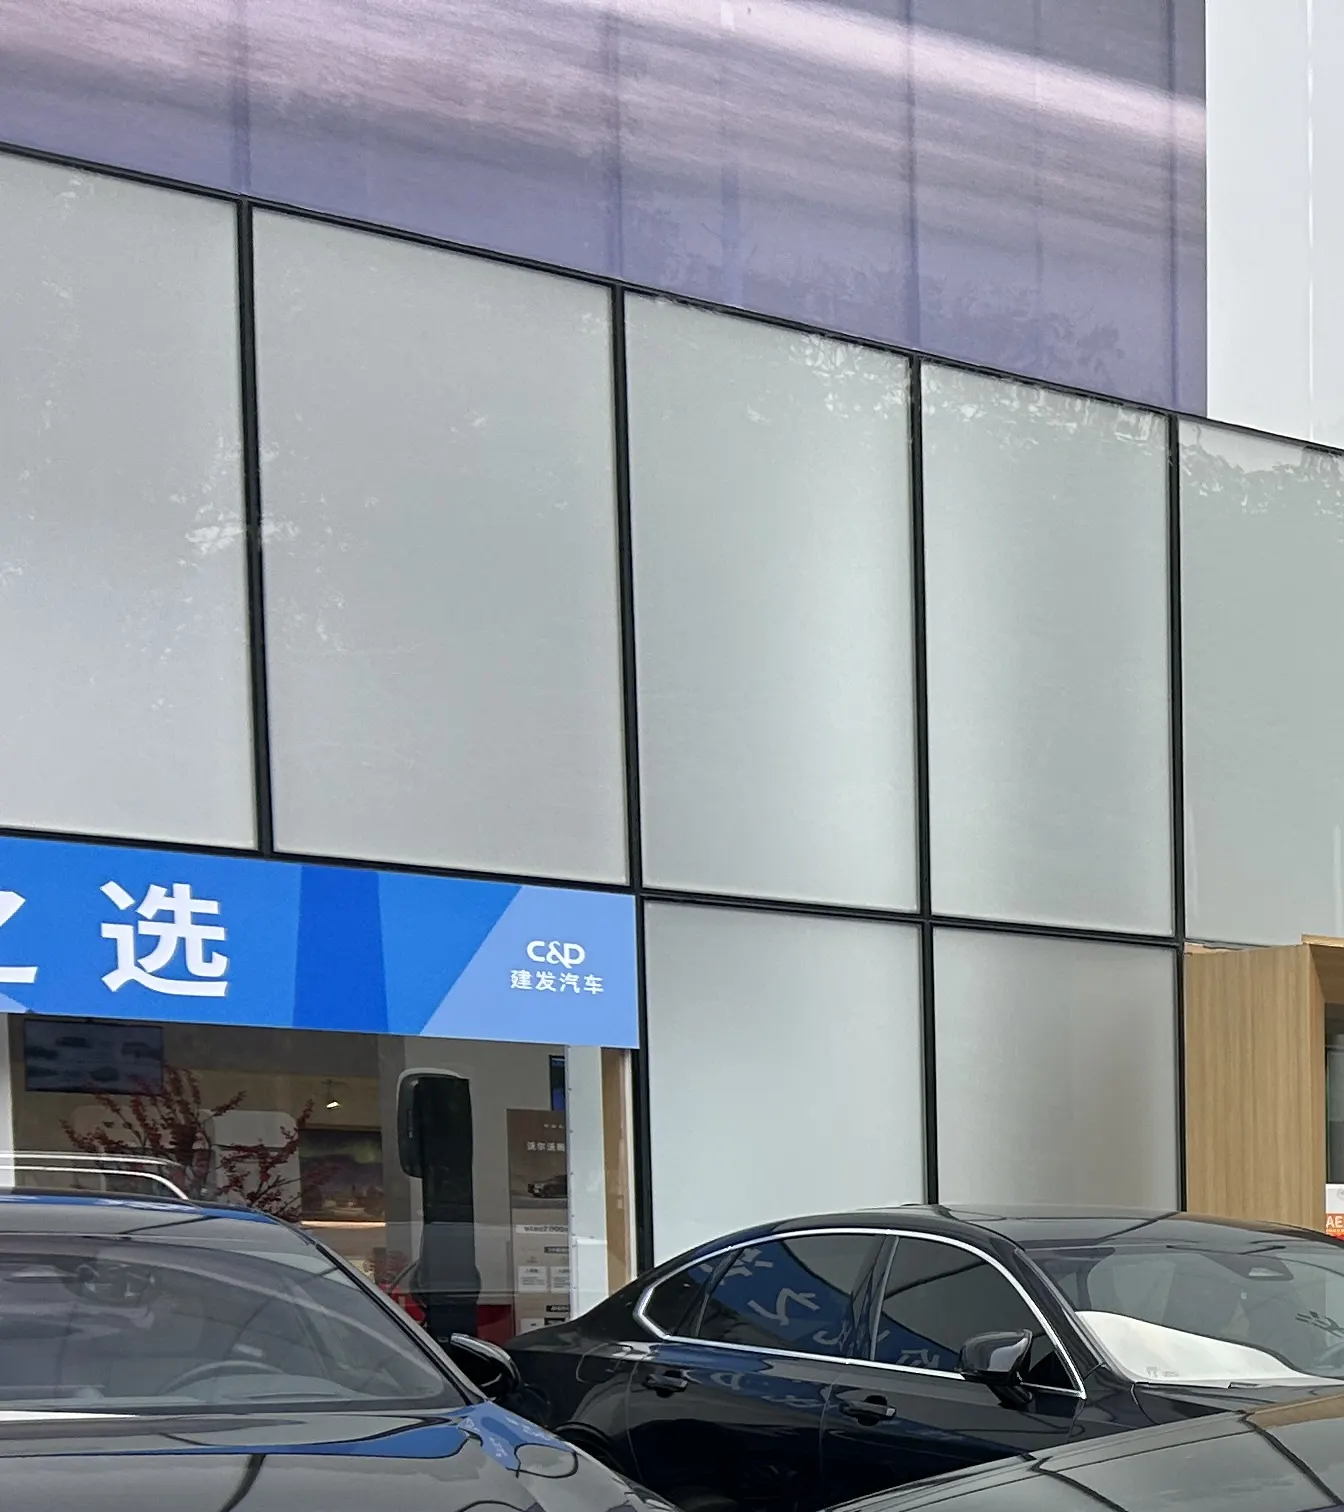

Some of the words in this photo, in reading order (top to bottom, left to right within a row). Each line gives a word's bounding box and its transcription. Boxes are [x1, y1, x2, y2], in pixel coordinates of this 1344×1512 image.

[526, 939, 586, 969] C&D
[510, 969, 604, 995] 建发汽车
